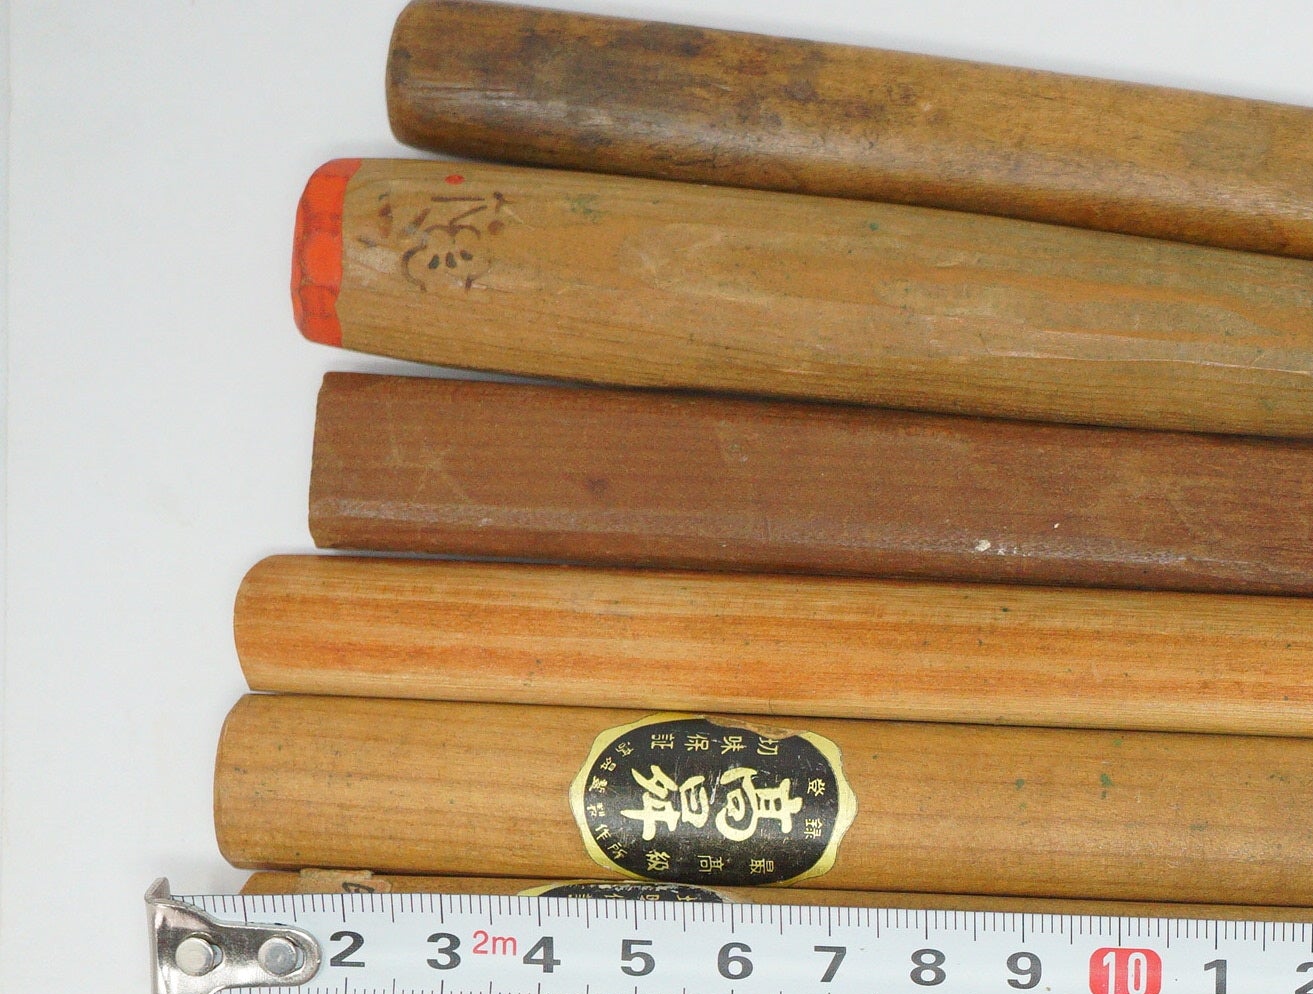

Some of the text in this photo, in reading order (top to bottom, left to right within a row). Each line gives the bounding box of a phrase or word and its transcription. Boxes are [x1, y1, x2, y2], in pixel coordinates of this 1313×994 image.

[803, 777, 827, 840] 登録
[330, 931, 365, 967] 2
[426, 933, 461, 970] 3
[522, 937, 561, 974] 4
[620, 940, 655, 977] 5
[717, 943, 753, 980] 6
[814, 946, 847, 982] 7
[909, 949, 946, 986] 8
[1006, 952, 1042, 989] 9
[472, 930, 517, 955] 2m
